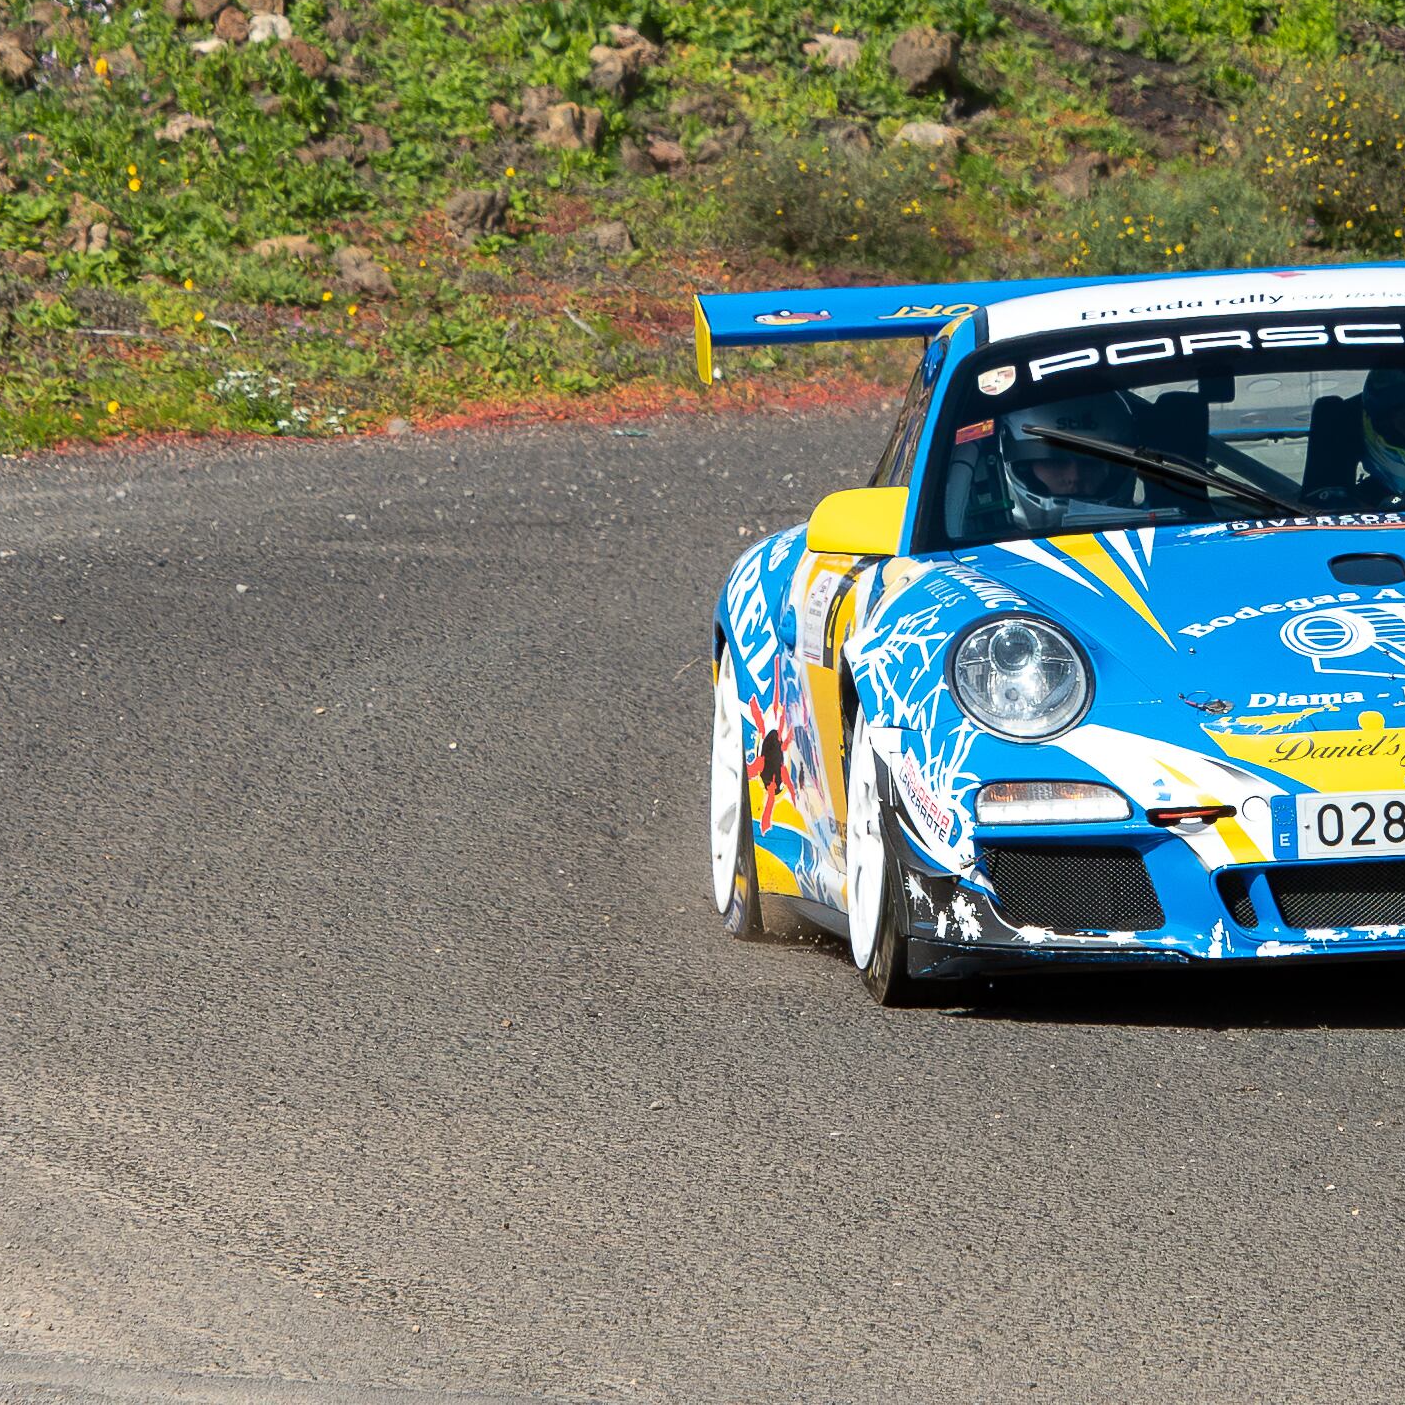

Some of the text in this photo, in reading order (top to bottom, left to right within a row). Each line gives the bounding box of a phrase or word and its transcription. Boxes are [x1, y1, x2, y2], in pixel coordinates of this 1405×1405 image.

[1081, 308, 1118, 321] En
[1129, 299, 1203, 314] cada
[1215, 292, 1283, 307] rally
[923, 579, 967, 608] VILLAS
[1178, 591, 1363, 639] Bodegas
[1247, 691, 1365, 709] Diama
[1268, 733, 1401, 763] Daniel's
[899, 766, 947, 843] LANZAROTE
[1280, 833, 1291, 847] E
